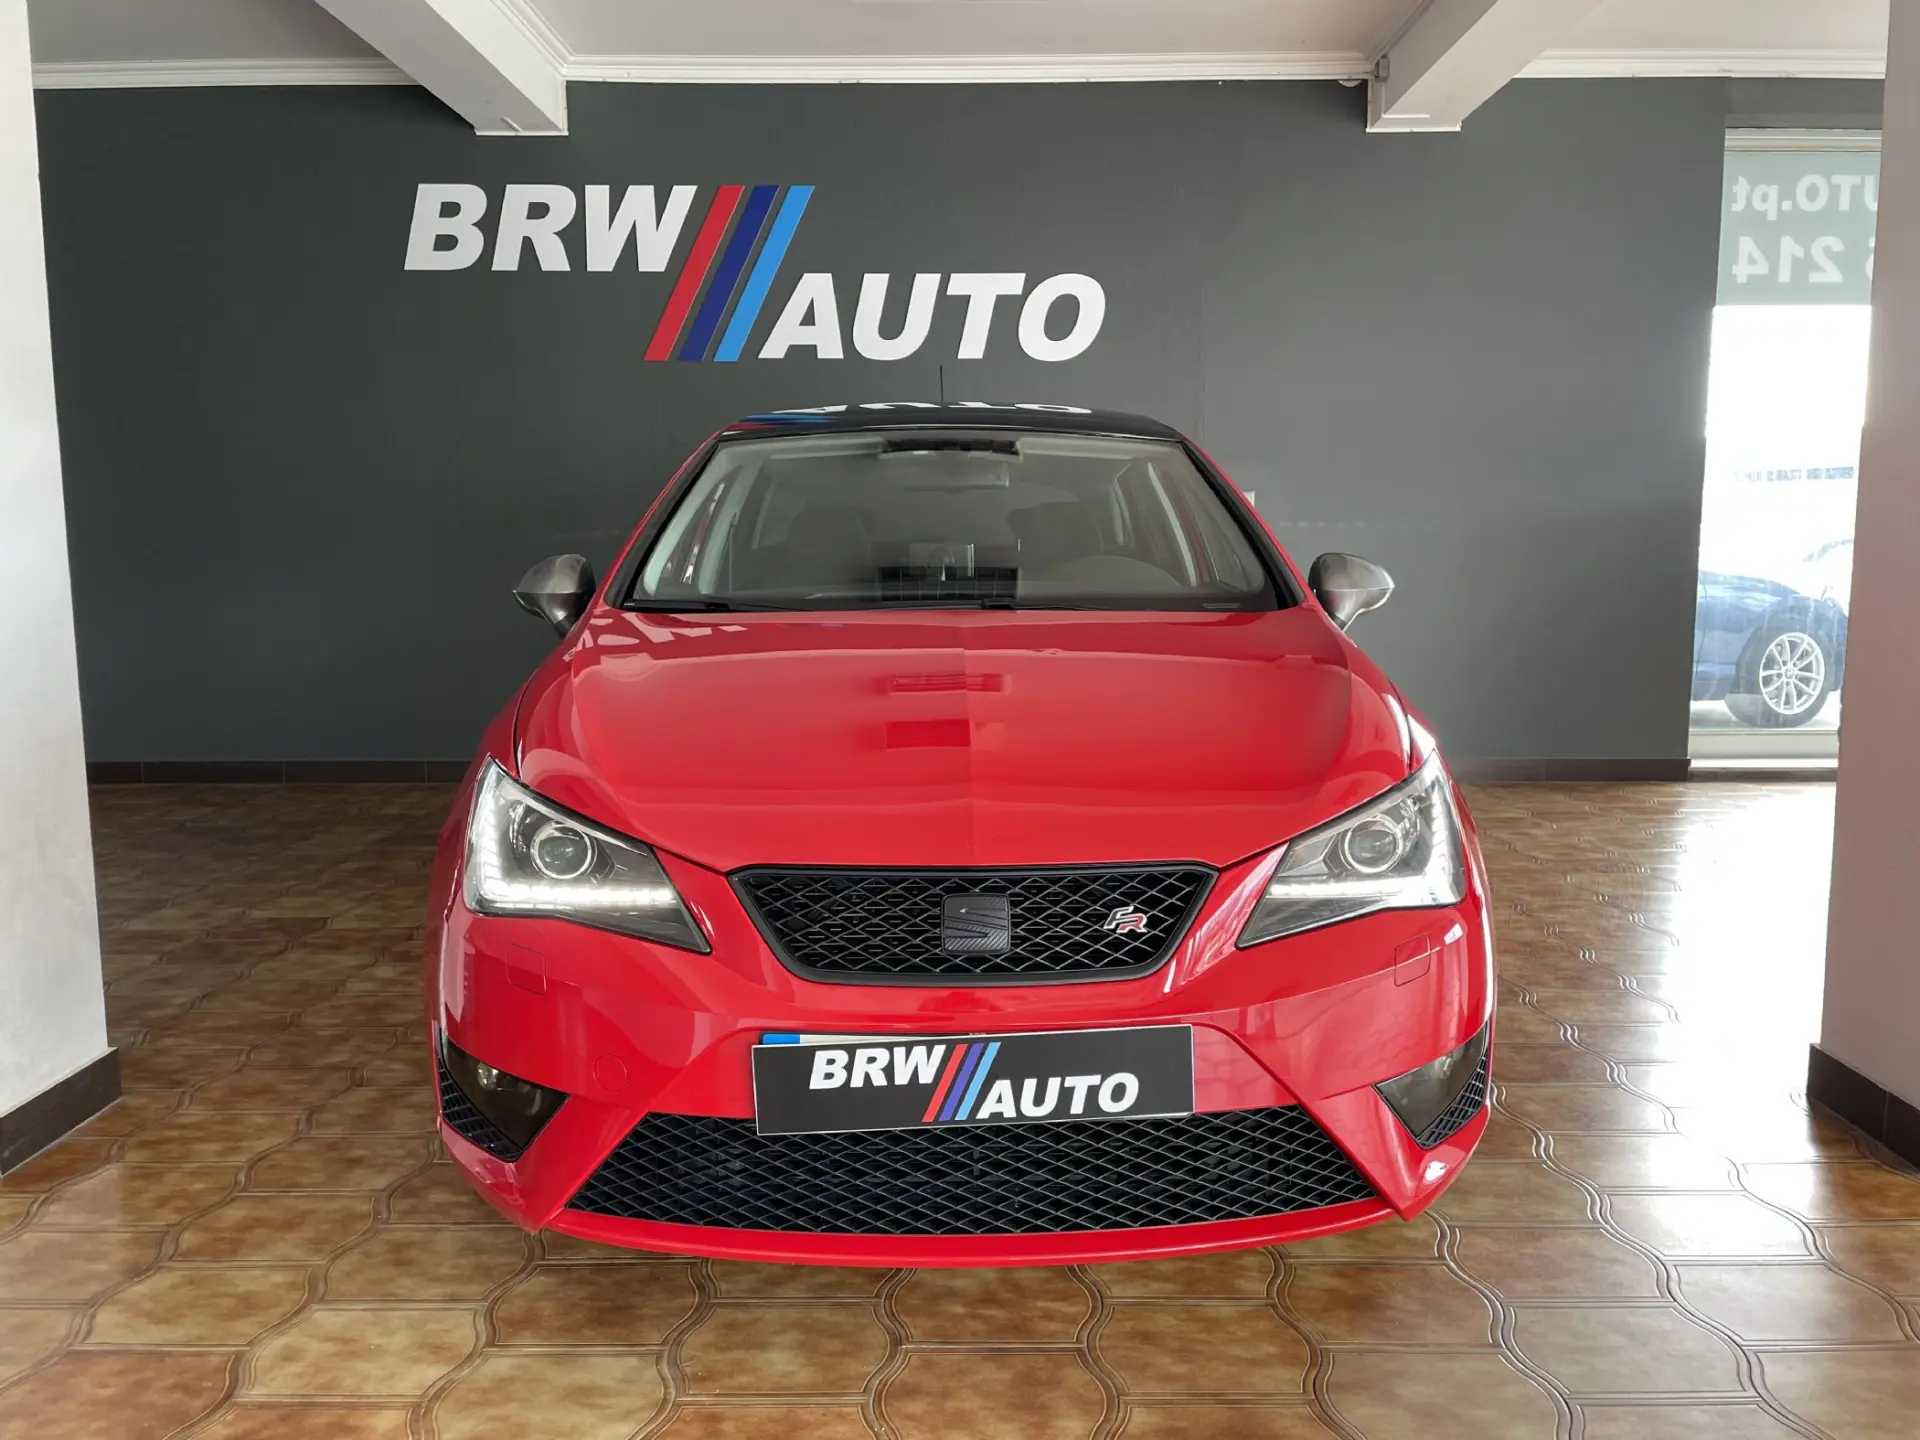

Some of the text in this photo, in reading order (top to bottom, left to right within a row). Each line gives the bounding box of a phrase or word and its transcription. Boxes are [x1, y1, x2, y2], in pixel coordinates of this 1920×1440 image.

[404, 184, 698, 272] BRW
[758, 272, 1106, 362] AUTO
[1103, 905, 1148, 933] FR
[809, 1044, 947, 1090] BRW
[975, 1072, 1139, 1120] AUTO
